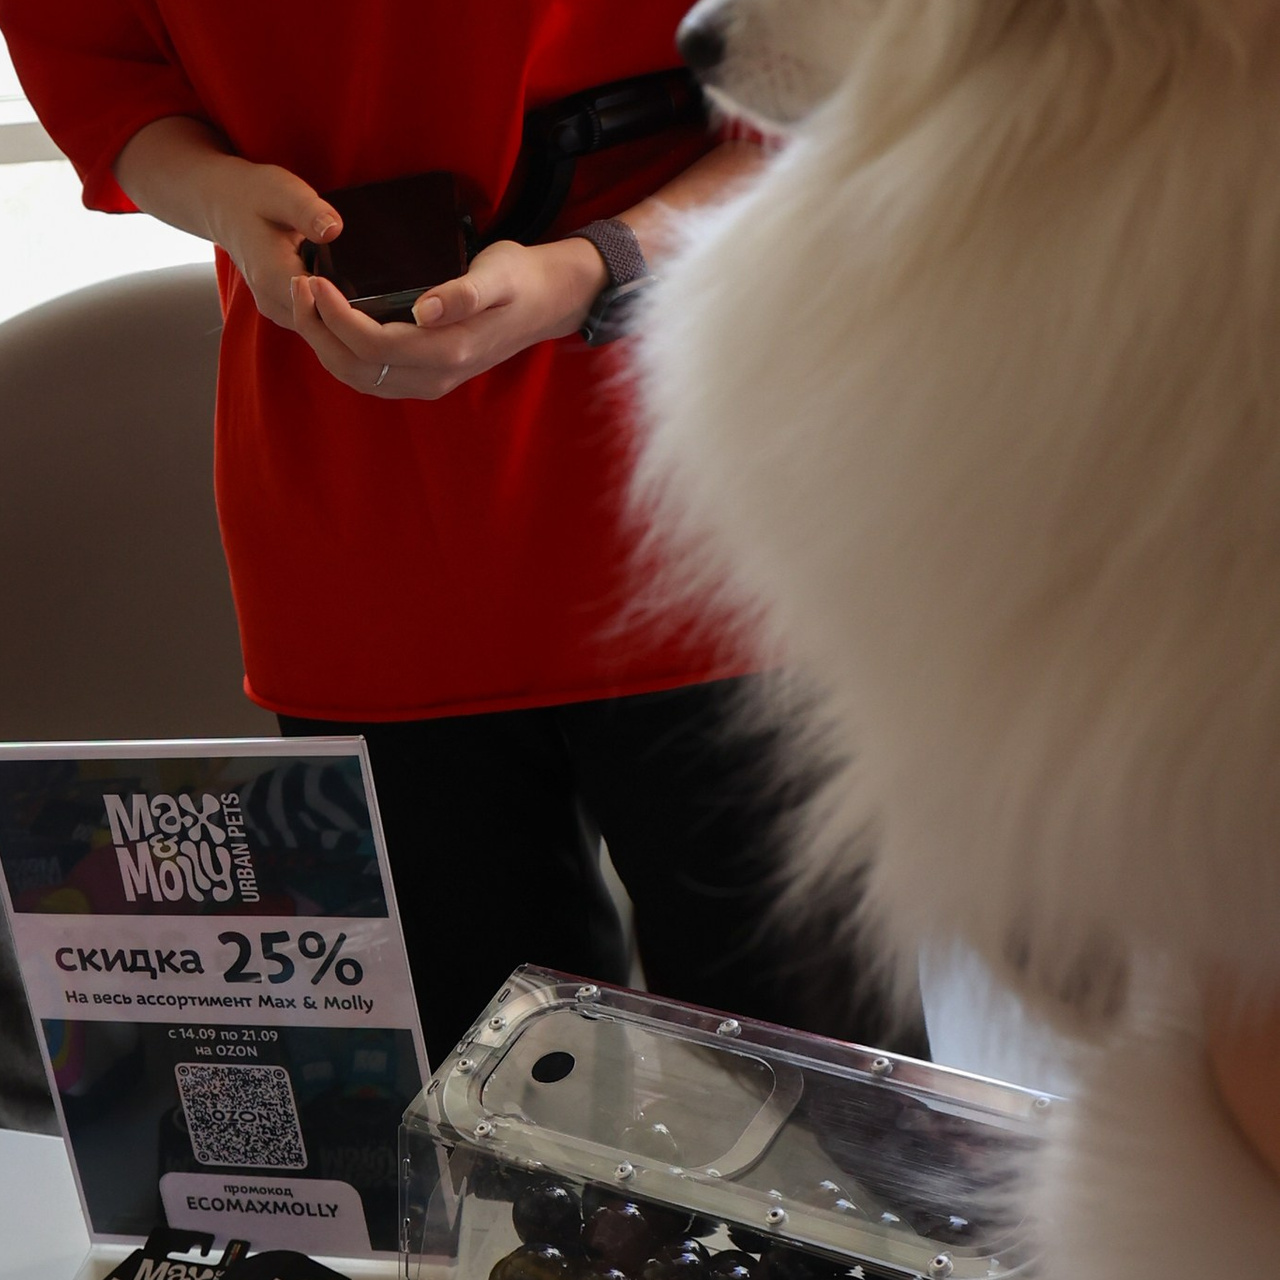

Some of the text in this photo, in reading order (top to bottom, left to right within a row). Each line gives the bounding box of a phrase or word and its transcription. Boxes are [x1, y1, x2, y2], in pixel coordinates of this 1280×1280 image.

[102, 793, 227, 846] Max
[149, 833, 179, 859] &
[220, 792, 261, 903] URBAN PETS
[115, 840, 234, 902] Molly
[55, 931, 364, 986] скидка 25%
[65, 990, 374, 1014] На весь ассортимент Max & Molly
[168, 1028, 279, 1042] с 14.09 по 21.09
[195, 1045, 259, 1058] на OZON
[212, 1110, 271, 1123] OZON
[223, 1184, 294, 1198] промокод
[186, 1196, 339, 1218] ECOMAXMOLLY
